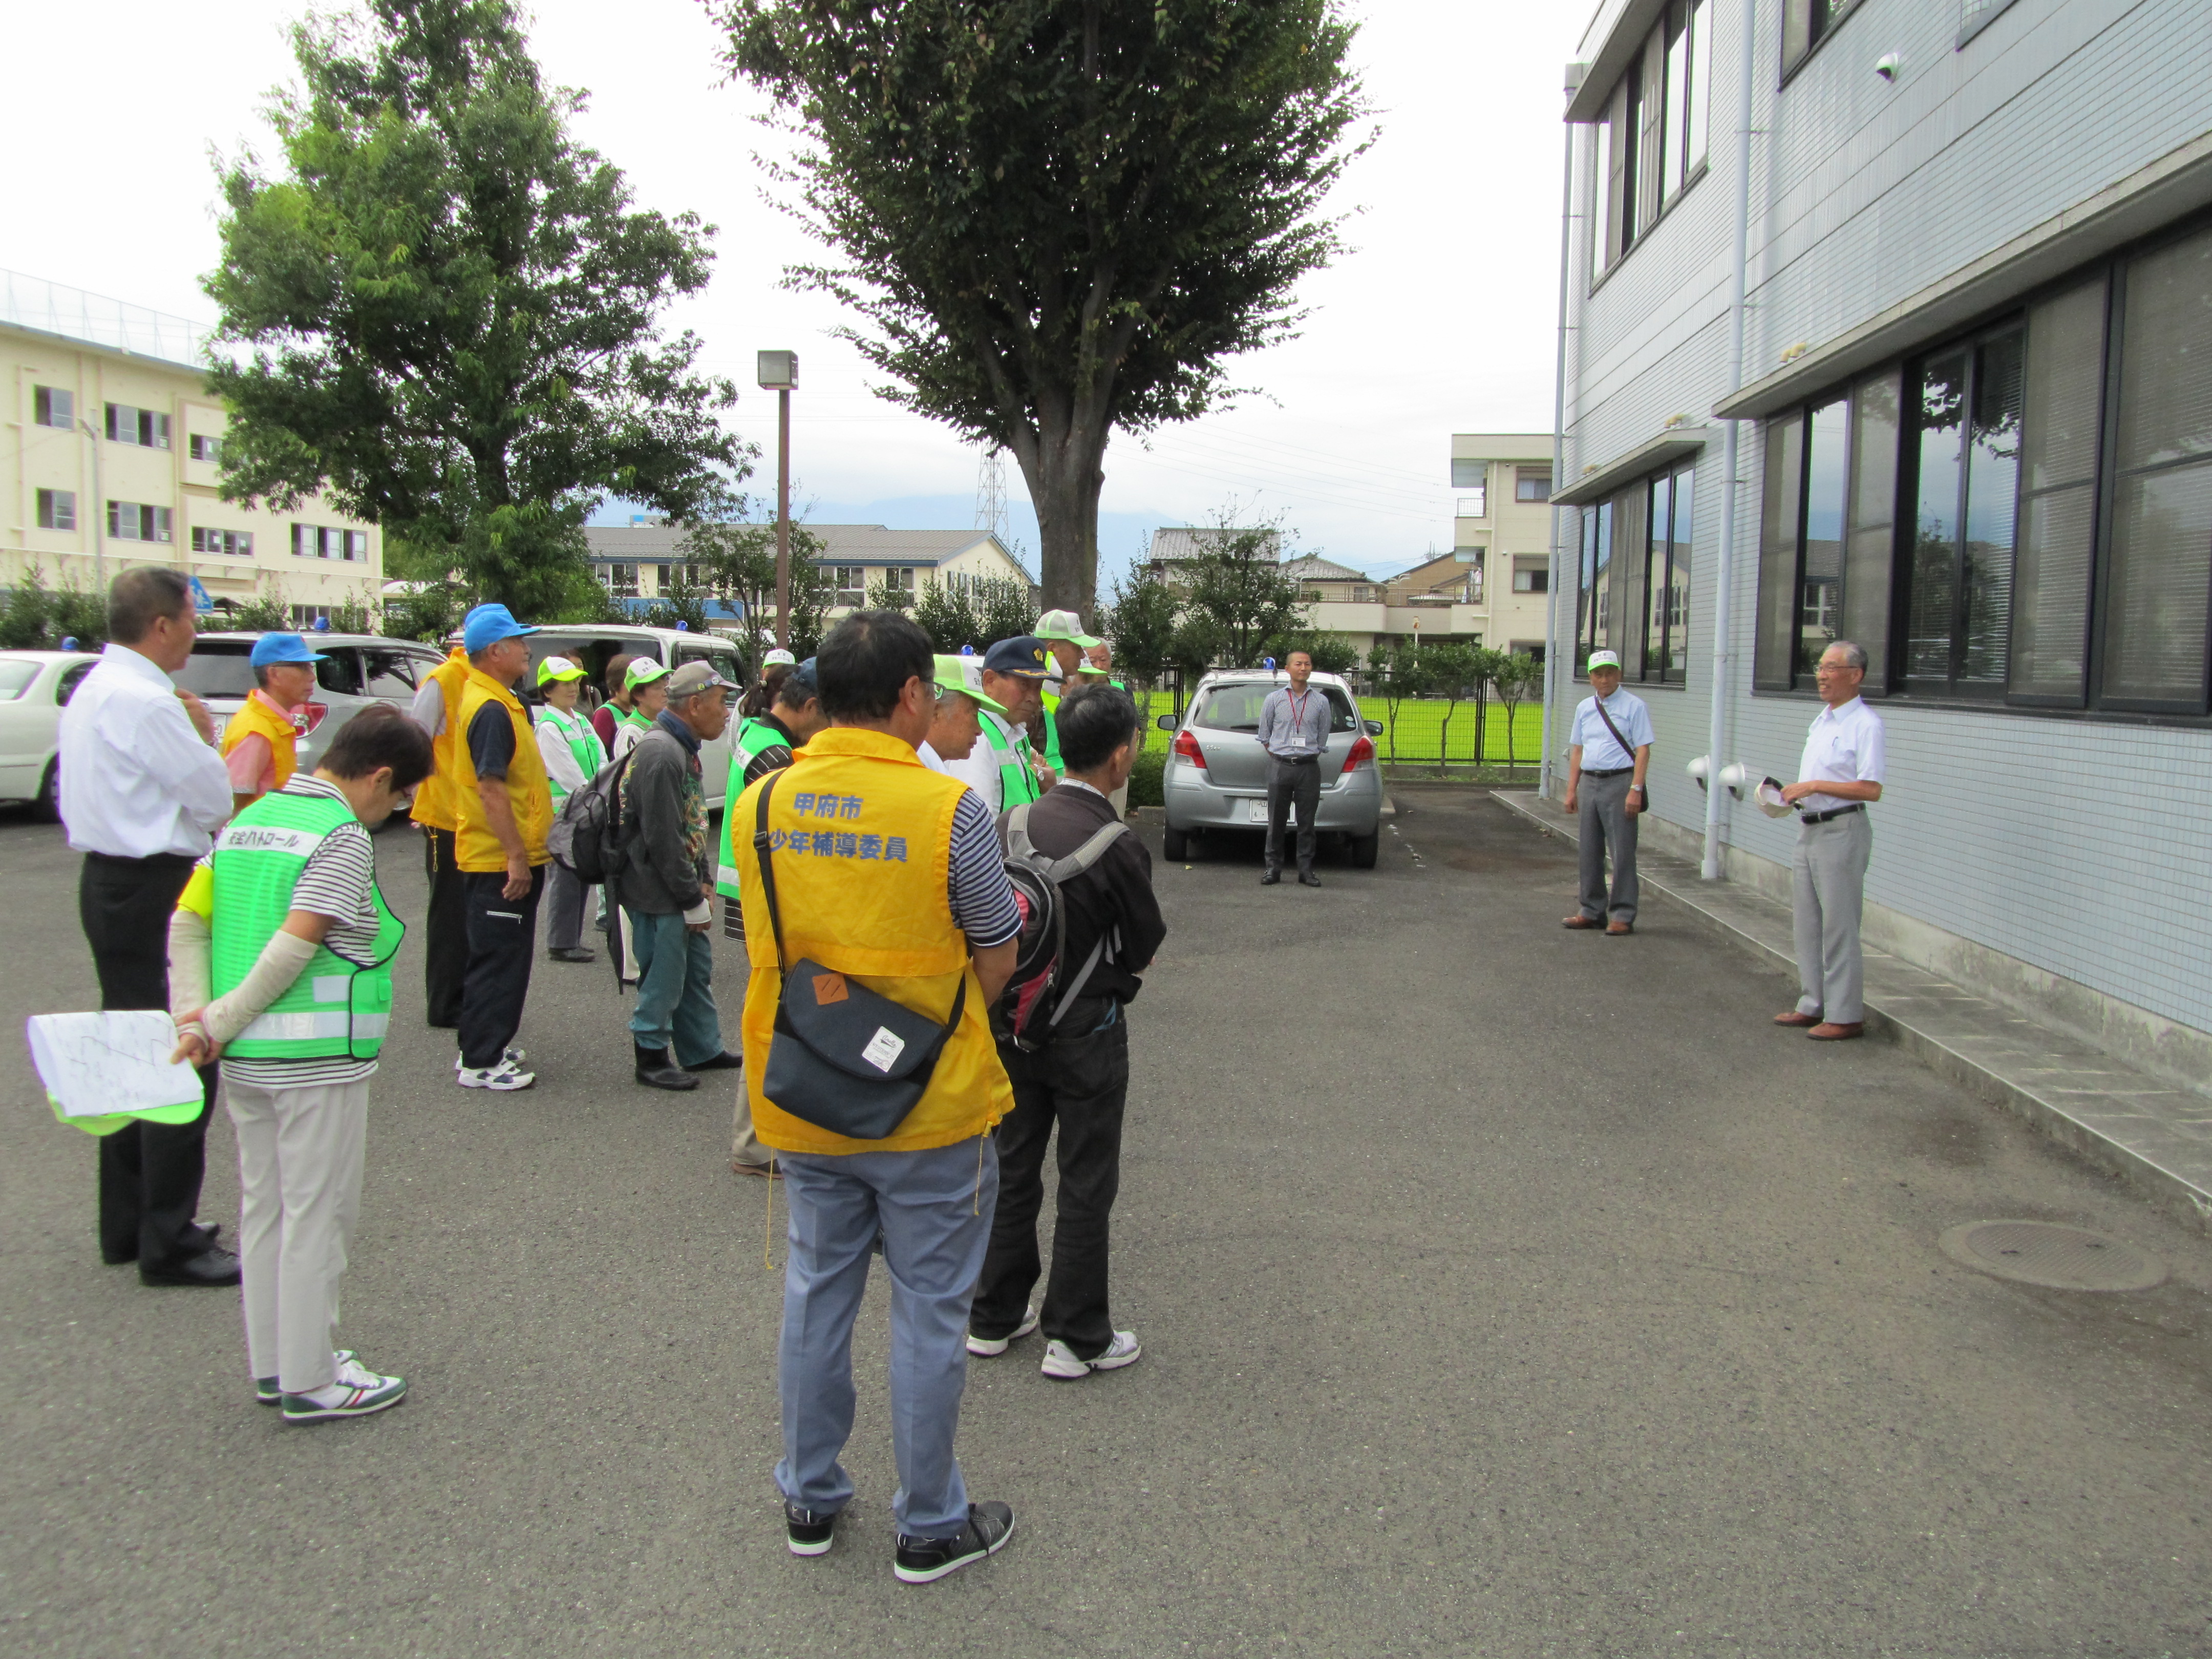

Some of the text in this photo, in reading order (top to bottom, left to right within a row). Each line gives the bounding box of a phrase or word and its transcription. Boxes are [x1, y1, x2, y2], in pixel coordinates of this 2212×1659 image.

[794, 793, 864, 819] 甲府市
[754, 828, 908, 863] 少年補導委員
